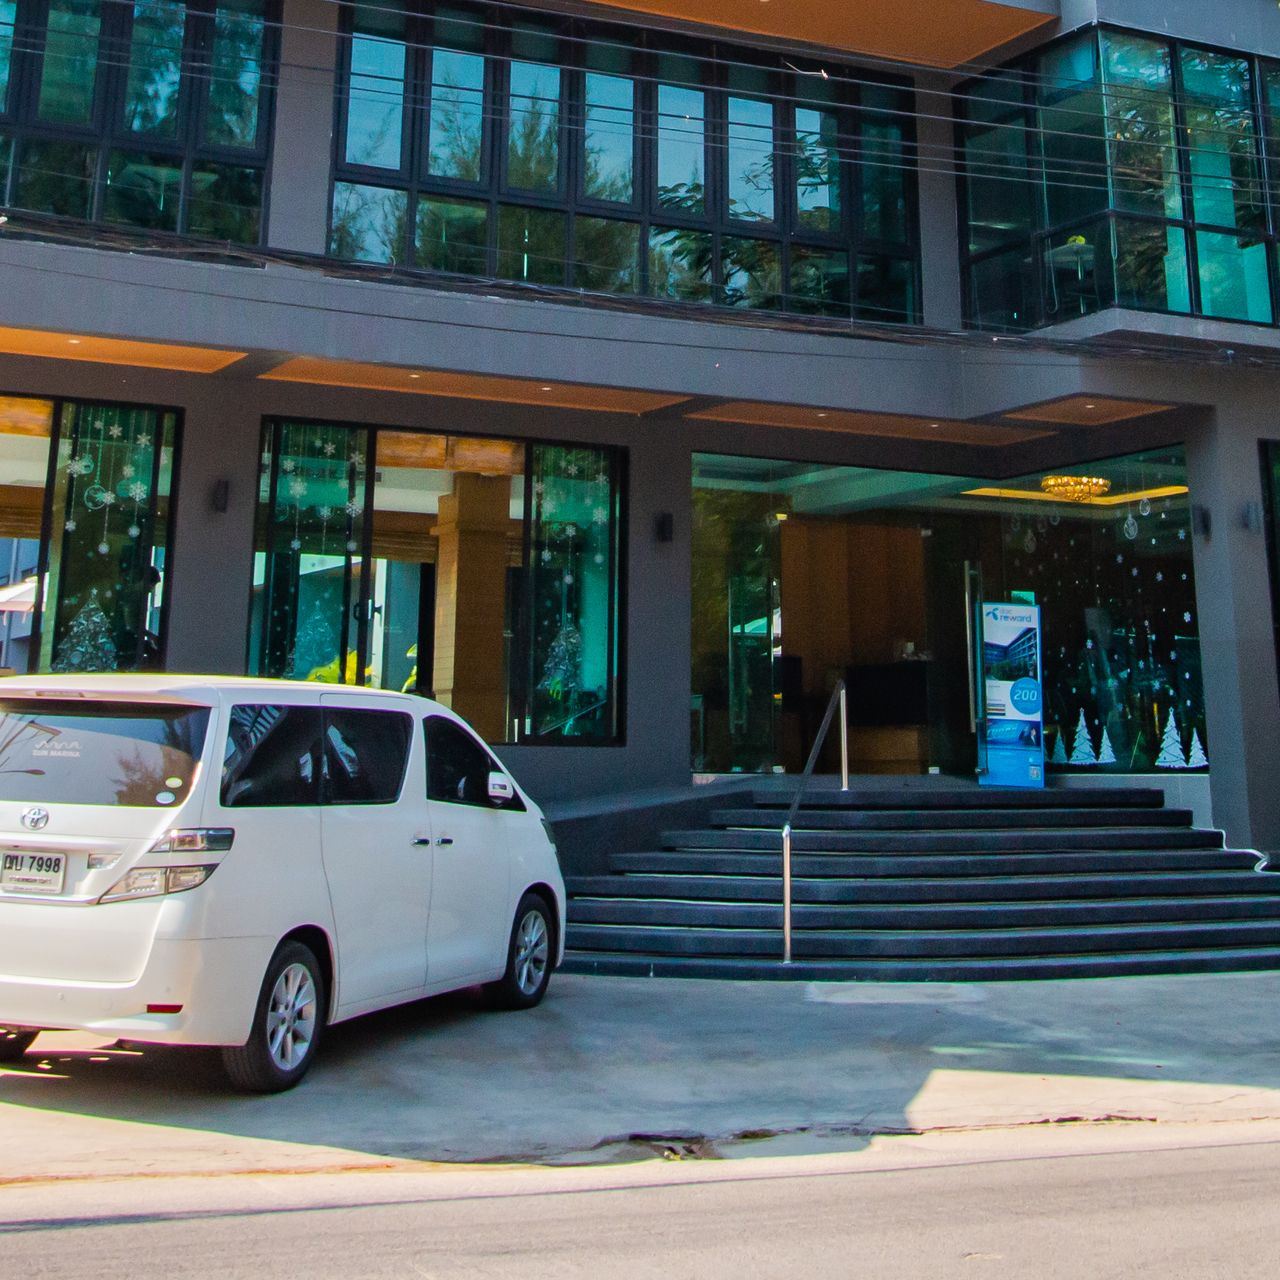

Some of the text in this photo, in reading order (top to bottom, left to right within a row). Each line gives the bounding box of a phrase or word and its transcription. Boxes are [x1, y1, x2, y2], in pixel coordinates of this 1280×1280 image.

[1000, 615, 1032, 623] reward
[1014, 689, 1037, 701] 200
[28, 856, 61, 873] 7998
